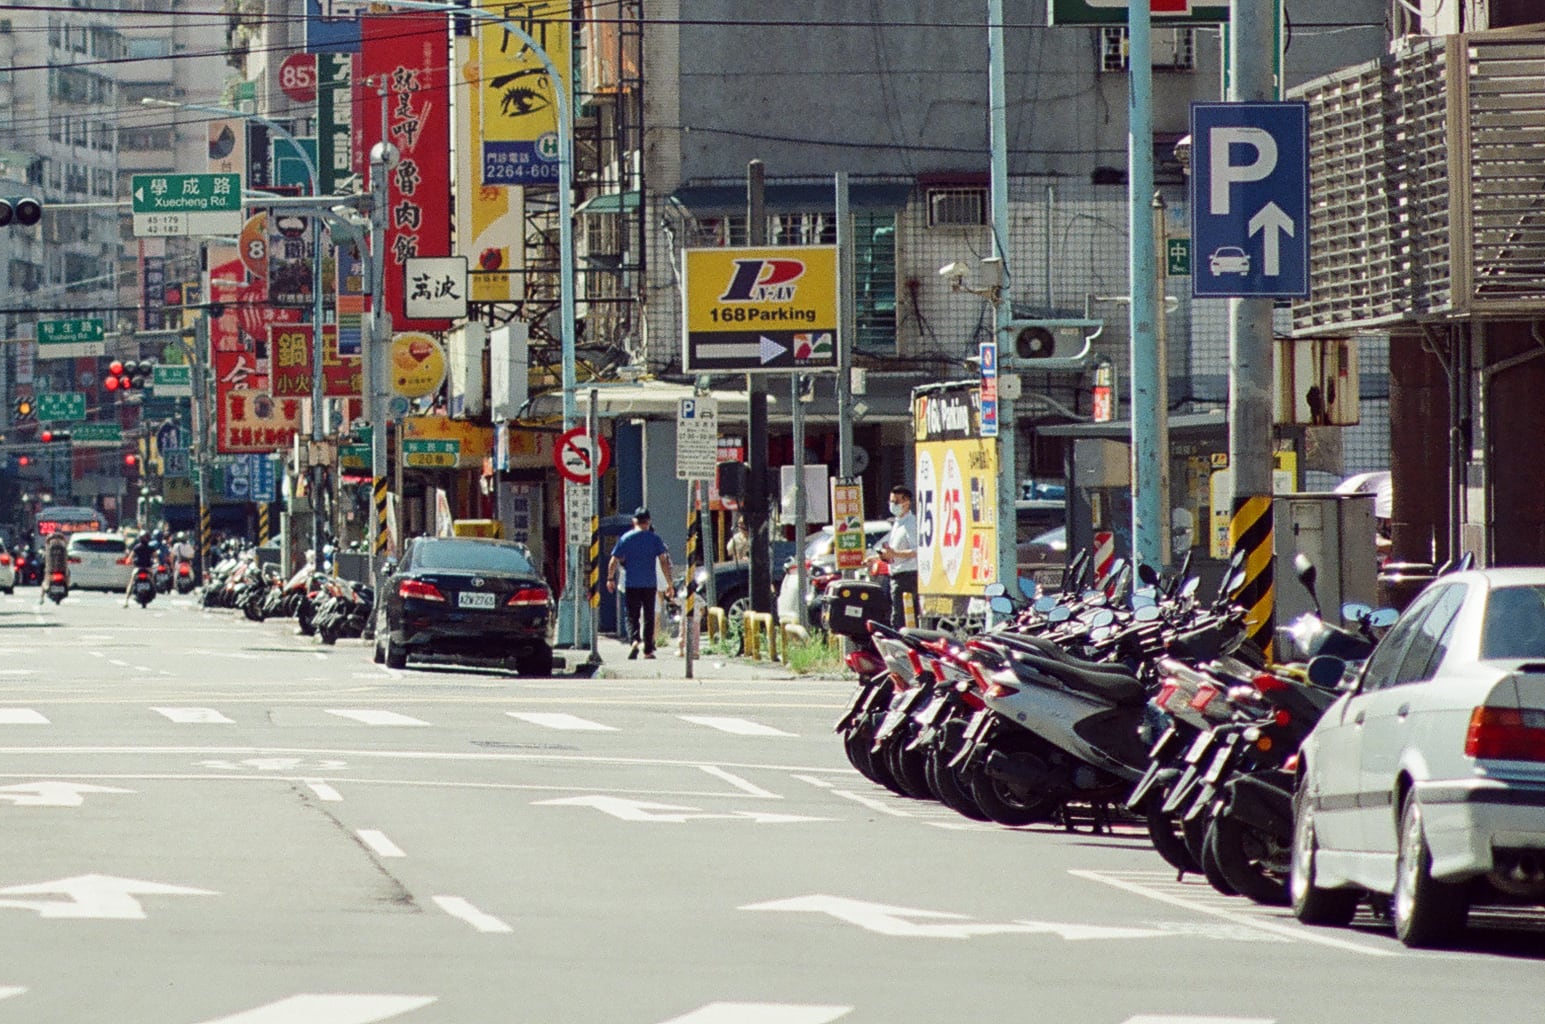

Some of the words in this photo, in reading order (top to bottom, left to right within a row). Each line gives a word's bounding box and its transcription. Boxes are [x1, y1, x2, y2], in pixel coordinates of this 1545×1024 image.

[487, 152, 530, 163] 門診電話
[487, 165, 559, 177] 2264-605
[1210, 127, 1278, 215] P
[150, 177, 231, 195] 學成路
[155, 197, 206, 208] Xuecheng
[210, 197, 229, 207] Rd.
[411, 273, 460, 300] 萬波
[683, 400, 694, 418] P
